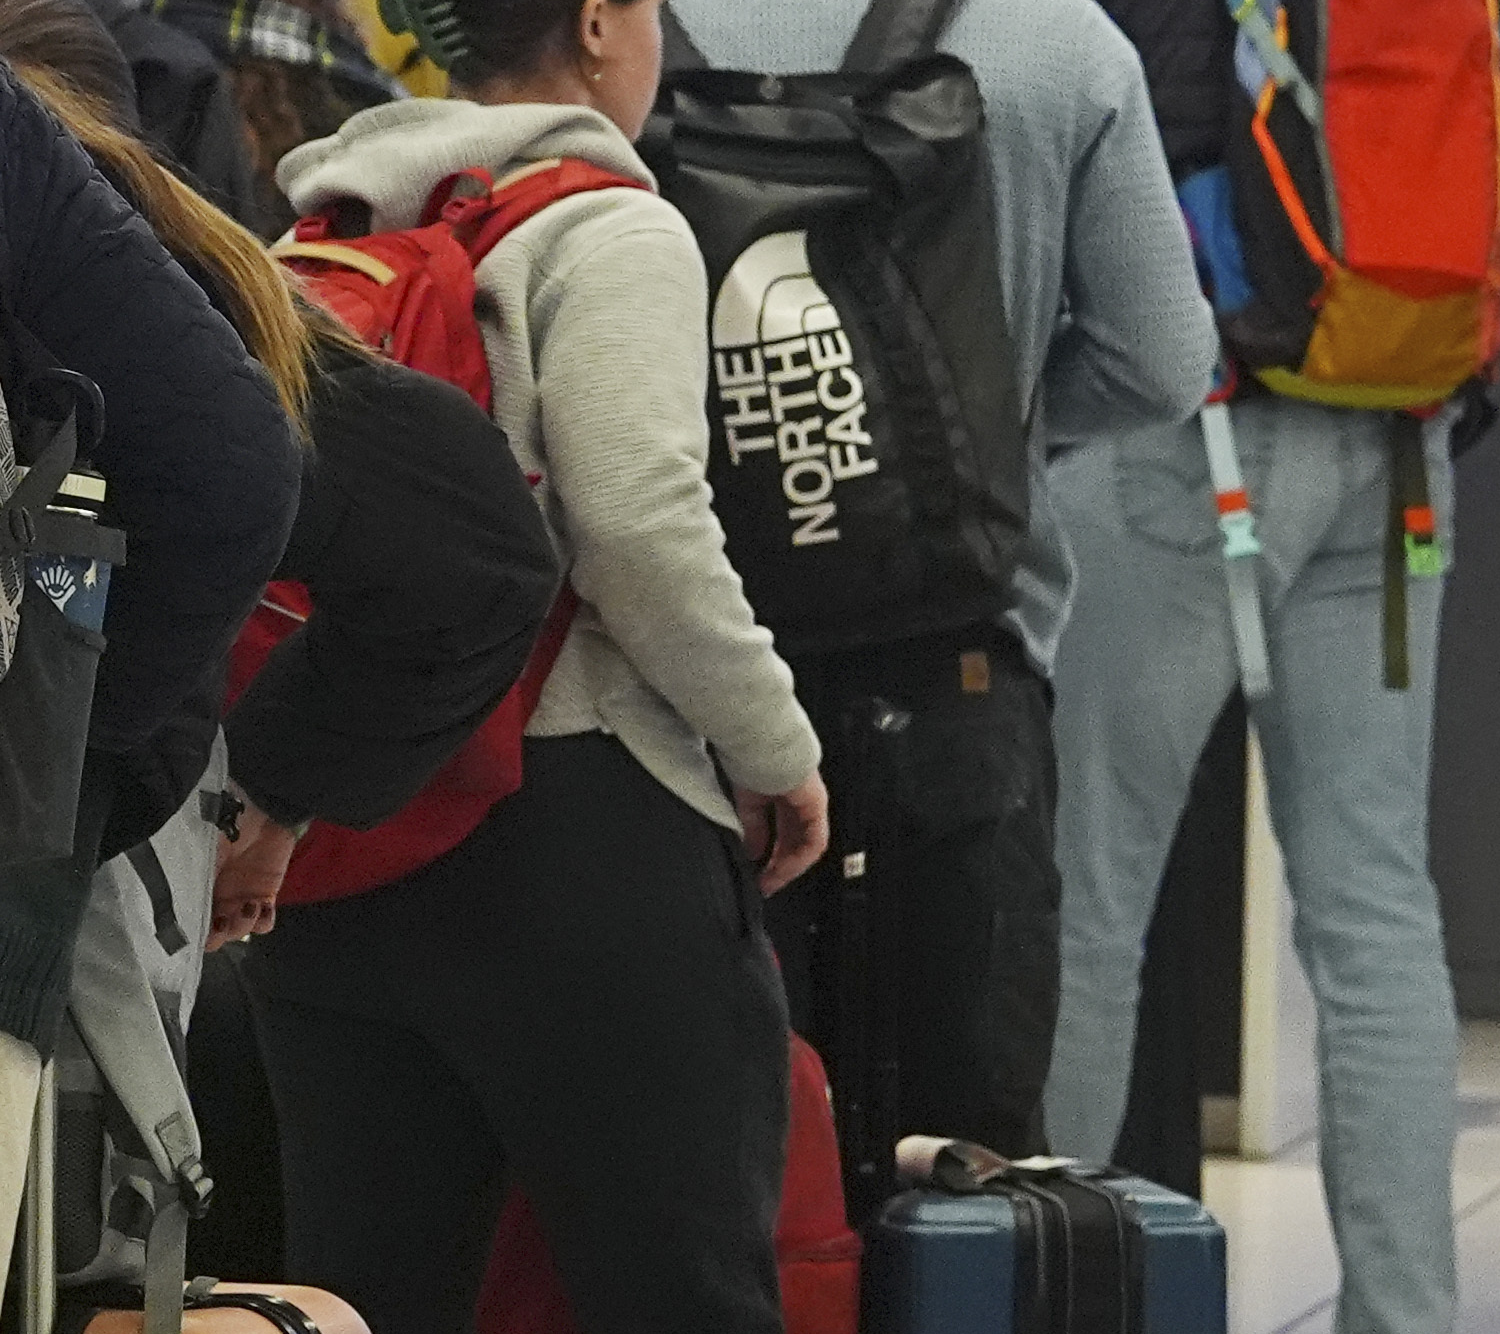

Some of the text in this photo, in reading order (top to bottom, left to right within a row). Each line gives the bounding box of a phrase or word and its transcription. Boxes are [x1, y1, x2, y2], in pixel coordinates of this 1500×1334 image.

[714, 346, 776, 466] THE
[762, 337, 841, 547] NORTH
[806, 328, 880, 482] FACE
